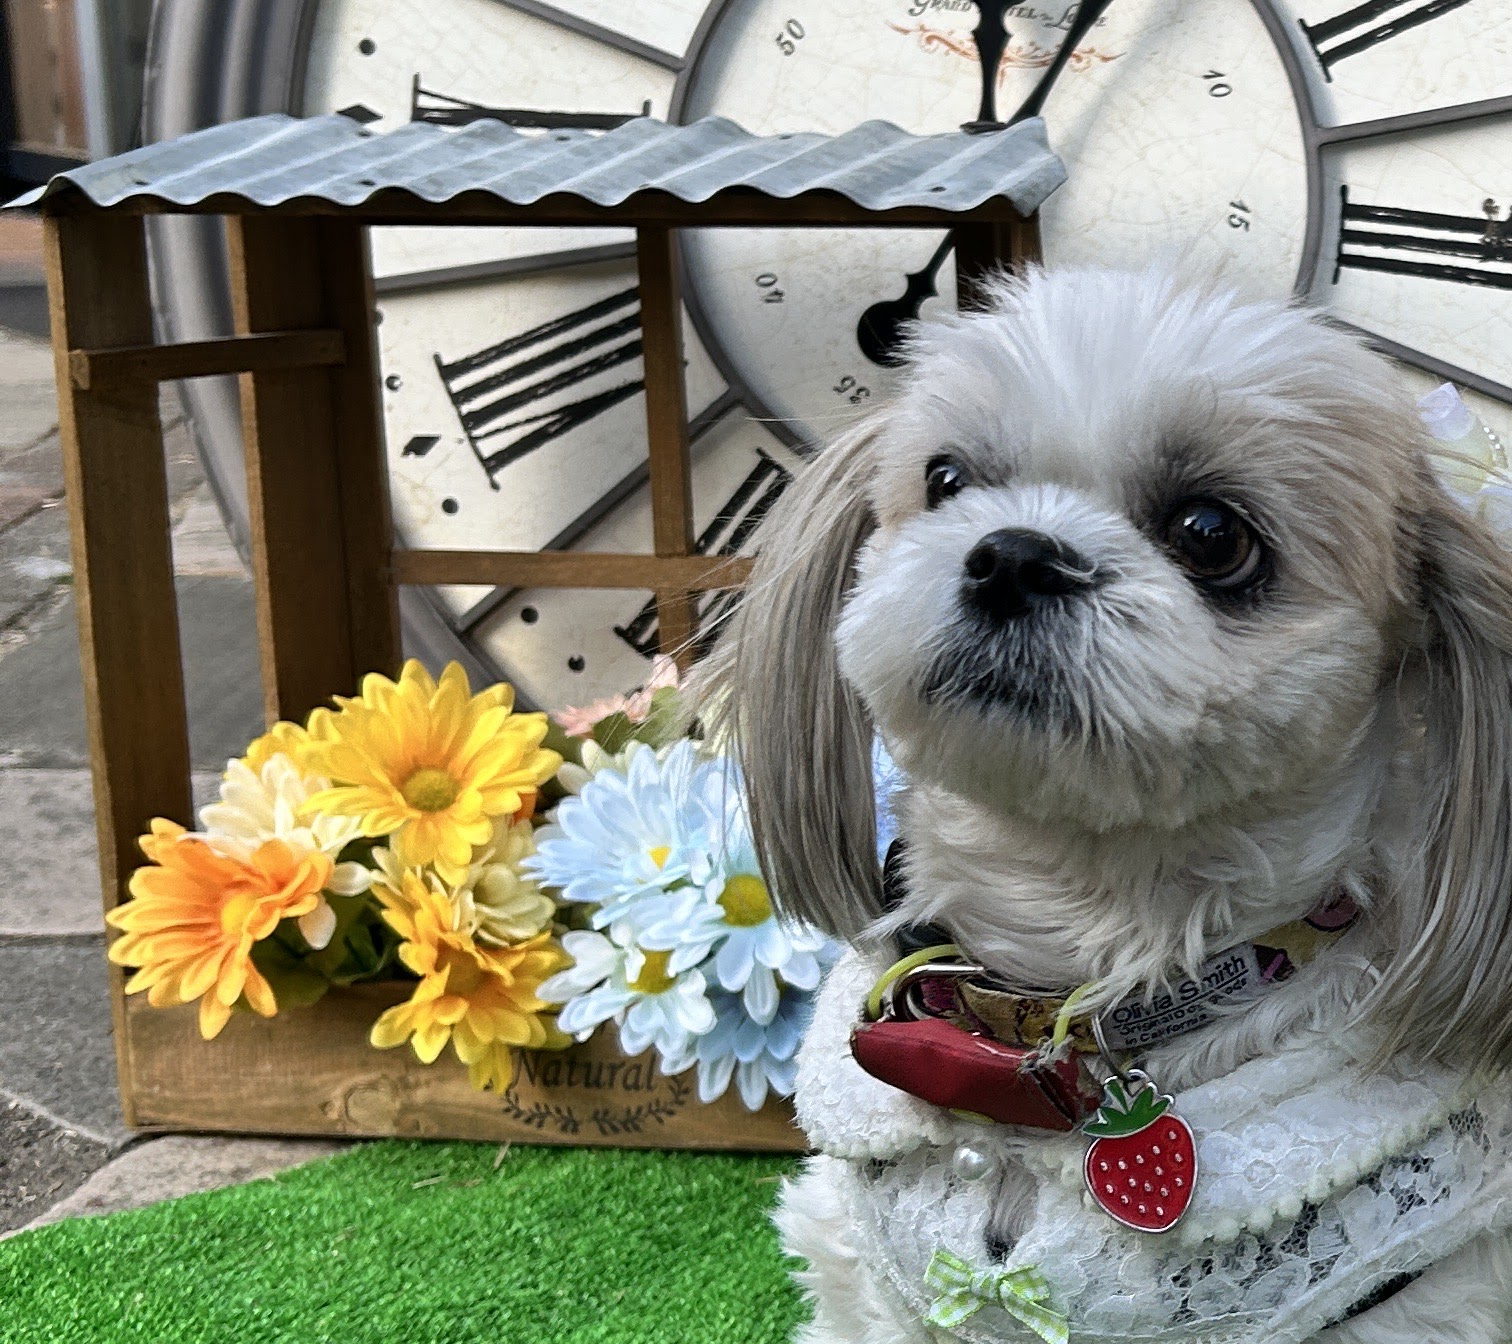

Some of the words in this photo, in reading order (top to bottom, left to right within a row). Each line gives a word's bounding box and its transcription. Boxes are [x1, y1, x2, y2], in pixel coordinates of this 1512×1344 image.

[775, 18, 806, 57] 50
[1201, 69, 1234, 98] 10
[1227, 199, 1252, 233] 15
[755, 271, 786, 304] 40
[832, 374, 871, 405] 35
[1112, 994, 1175, 1024] Olivia
[1178, 955, 1247, 1002] Smith
[507, 1049, 658, 1091] Natural
